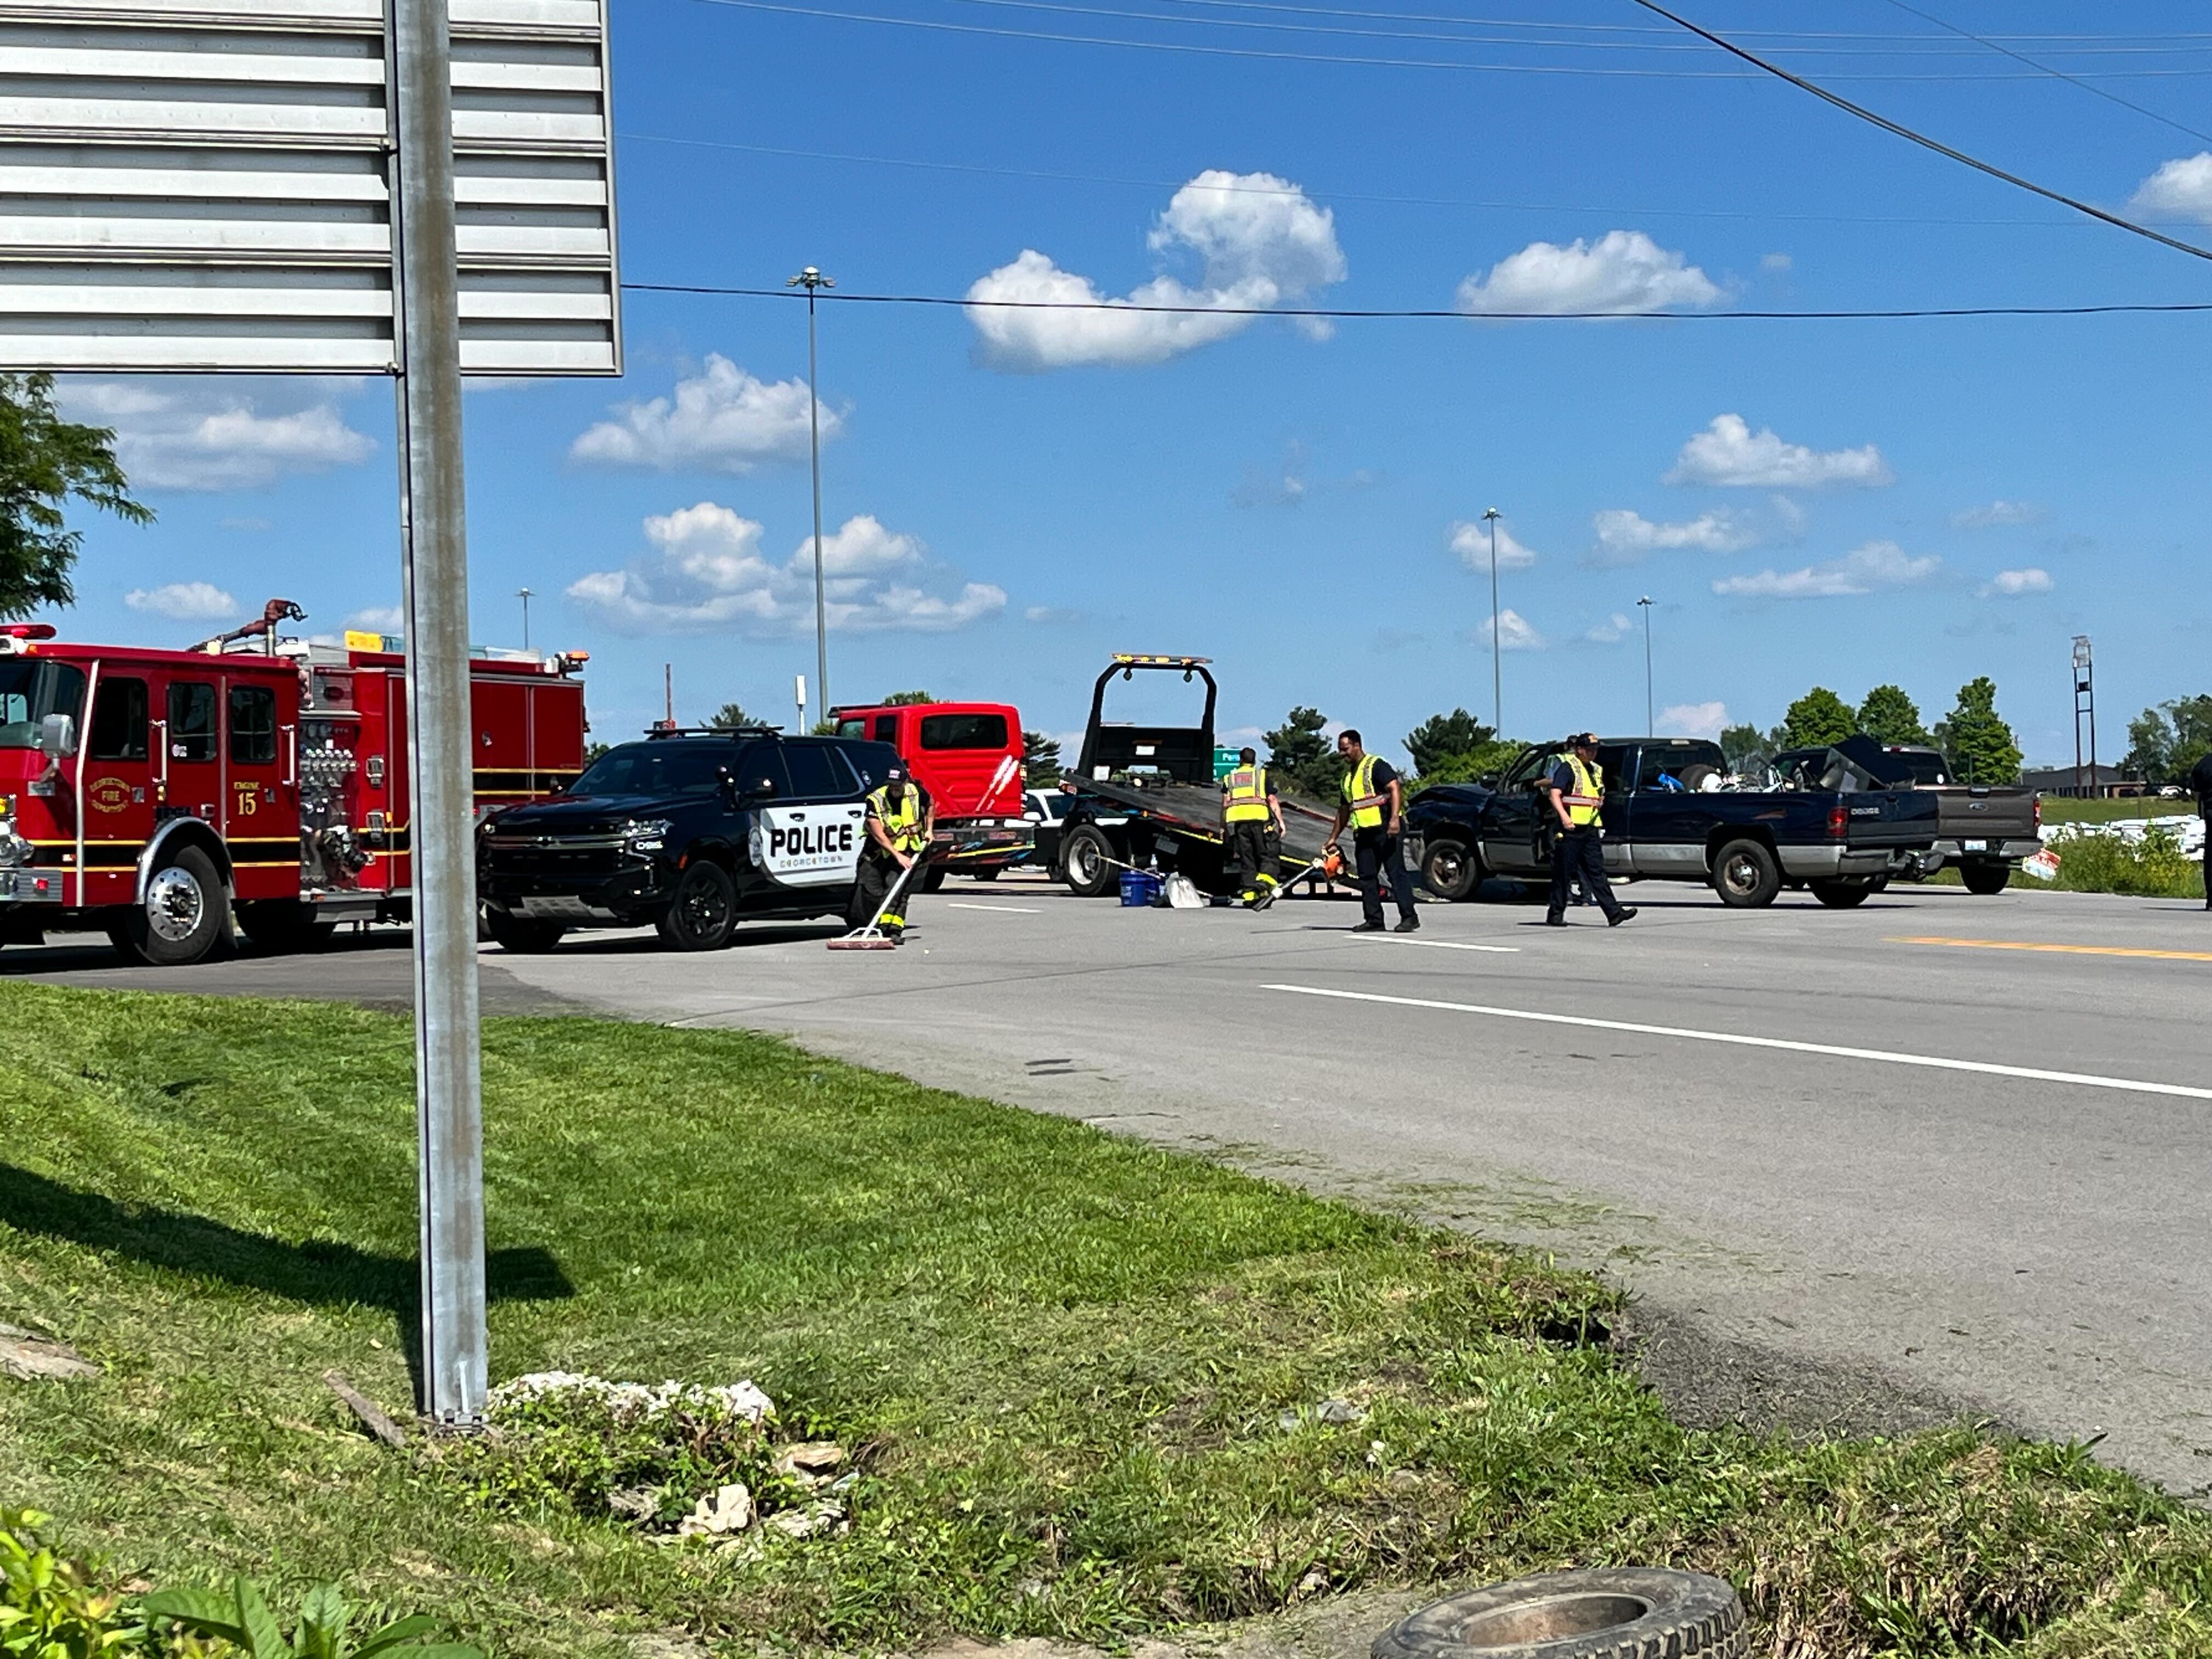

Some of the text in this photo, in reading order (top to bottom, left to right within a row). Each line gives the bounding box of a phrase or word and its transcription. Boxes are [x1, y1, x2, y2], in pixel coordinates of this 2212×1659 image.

[101, 791, 120, 802] FIRE
[238, 792, 256, 815] 15
[770, 823, 853, 857] POLICE
